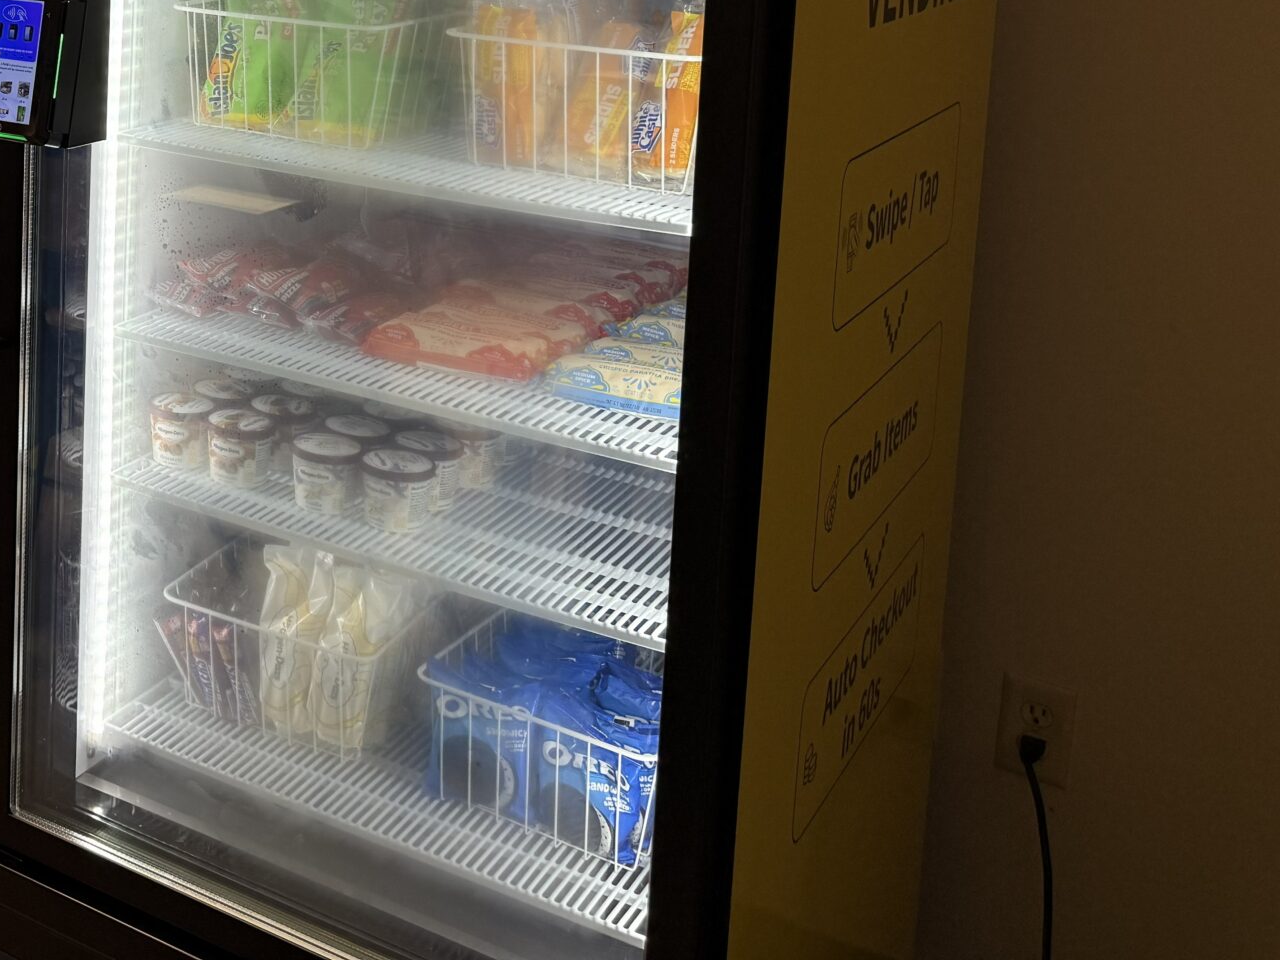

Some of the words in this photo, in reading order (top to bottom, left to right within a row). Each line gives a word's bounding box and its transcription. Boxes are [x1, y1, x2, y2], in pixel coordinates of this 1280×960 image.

[865, 193, 909, 249] Swipe
[919, 167, 940, 214] Tap
[846, 430, 882, 501] Grab
[884, 398, 919, 462] Items
[822, 653, 858, 727] Auto
[860, 562, 920, 671] Checkout
[840, 713, 856, 760] in
[858, 675, 882, 738] 60s
